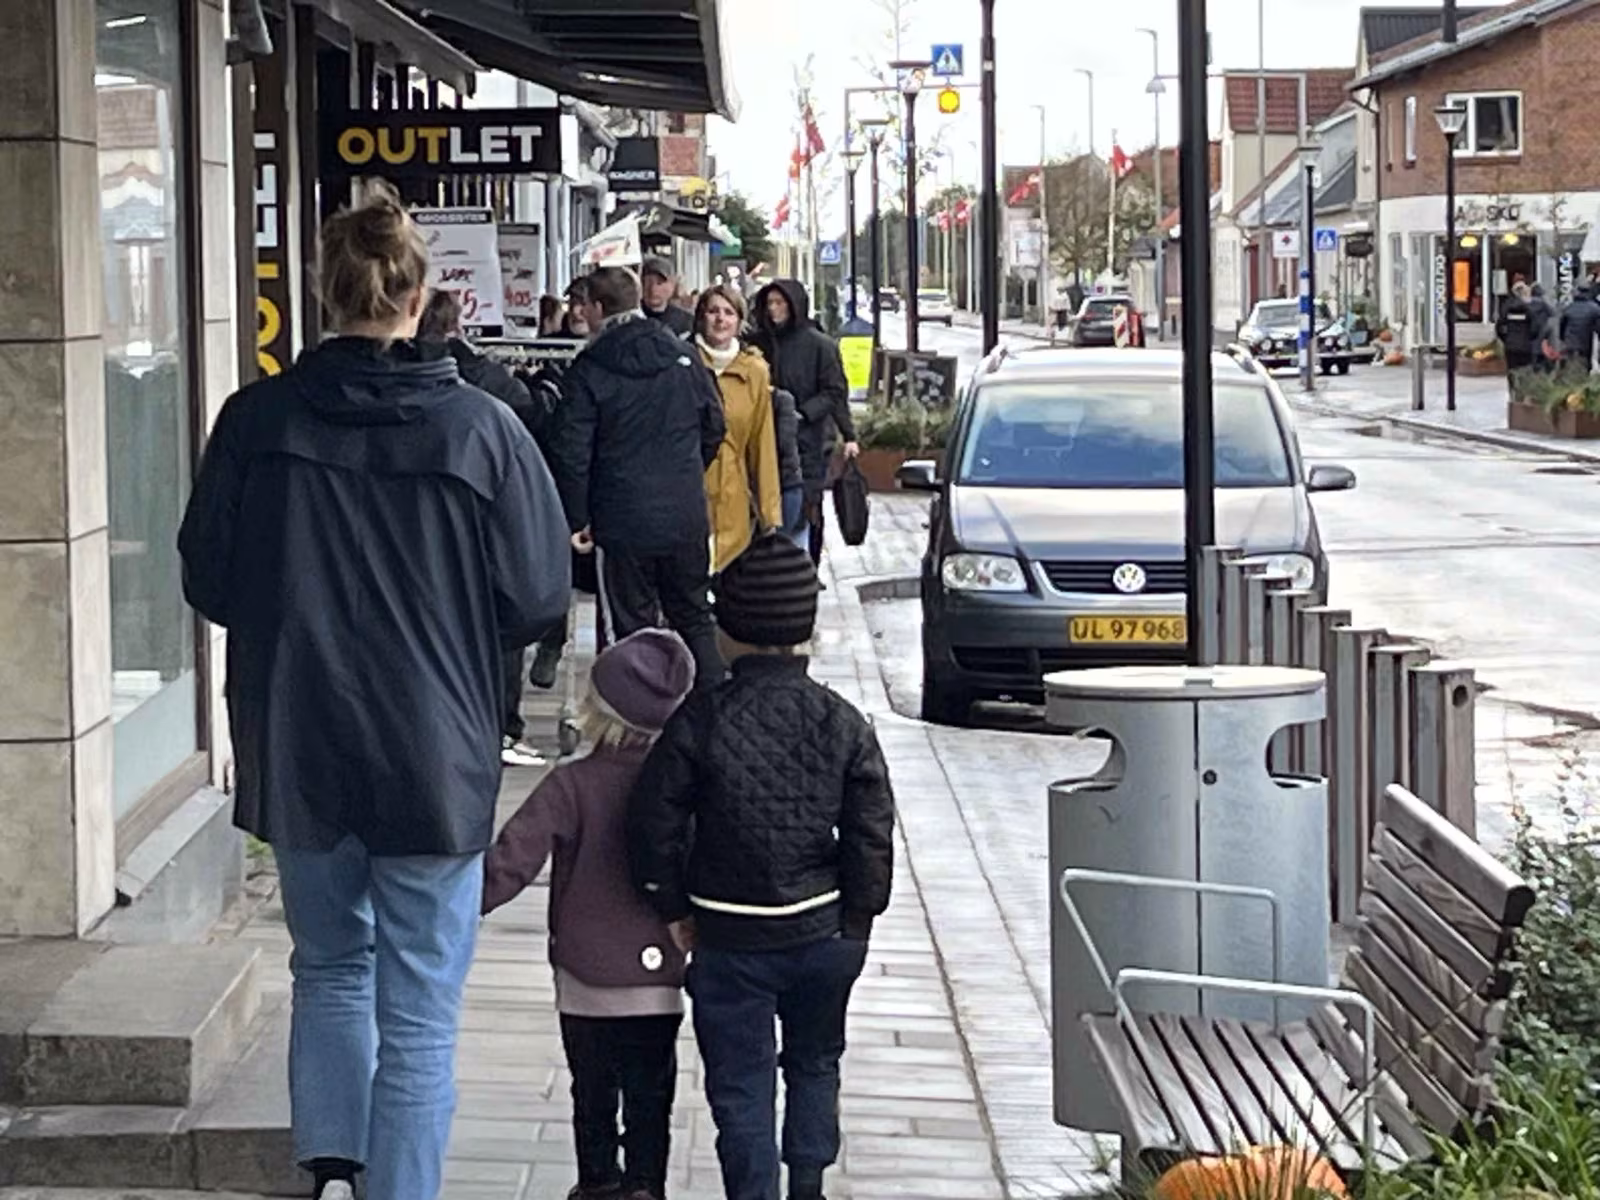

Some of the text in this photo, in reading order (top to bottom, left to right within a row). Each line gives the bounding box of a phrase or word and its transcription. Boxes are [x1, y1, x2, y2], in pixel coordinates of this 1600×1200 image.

[338, 126, 542, 164] OUTLET
[1074, 620, 1103, 640] UL
[1111, 619, 1138, 640] 97
